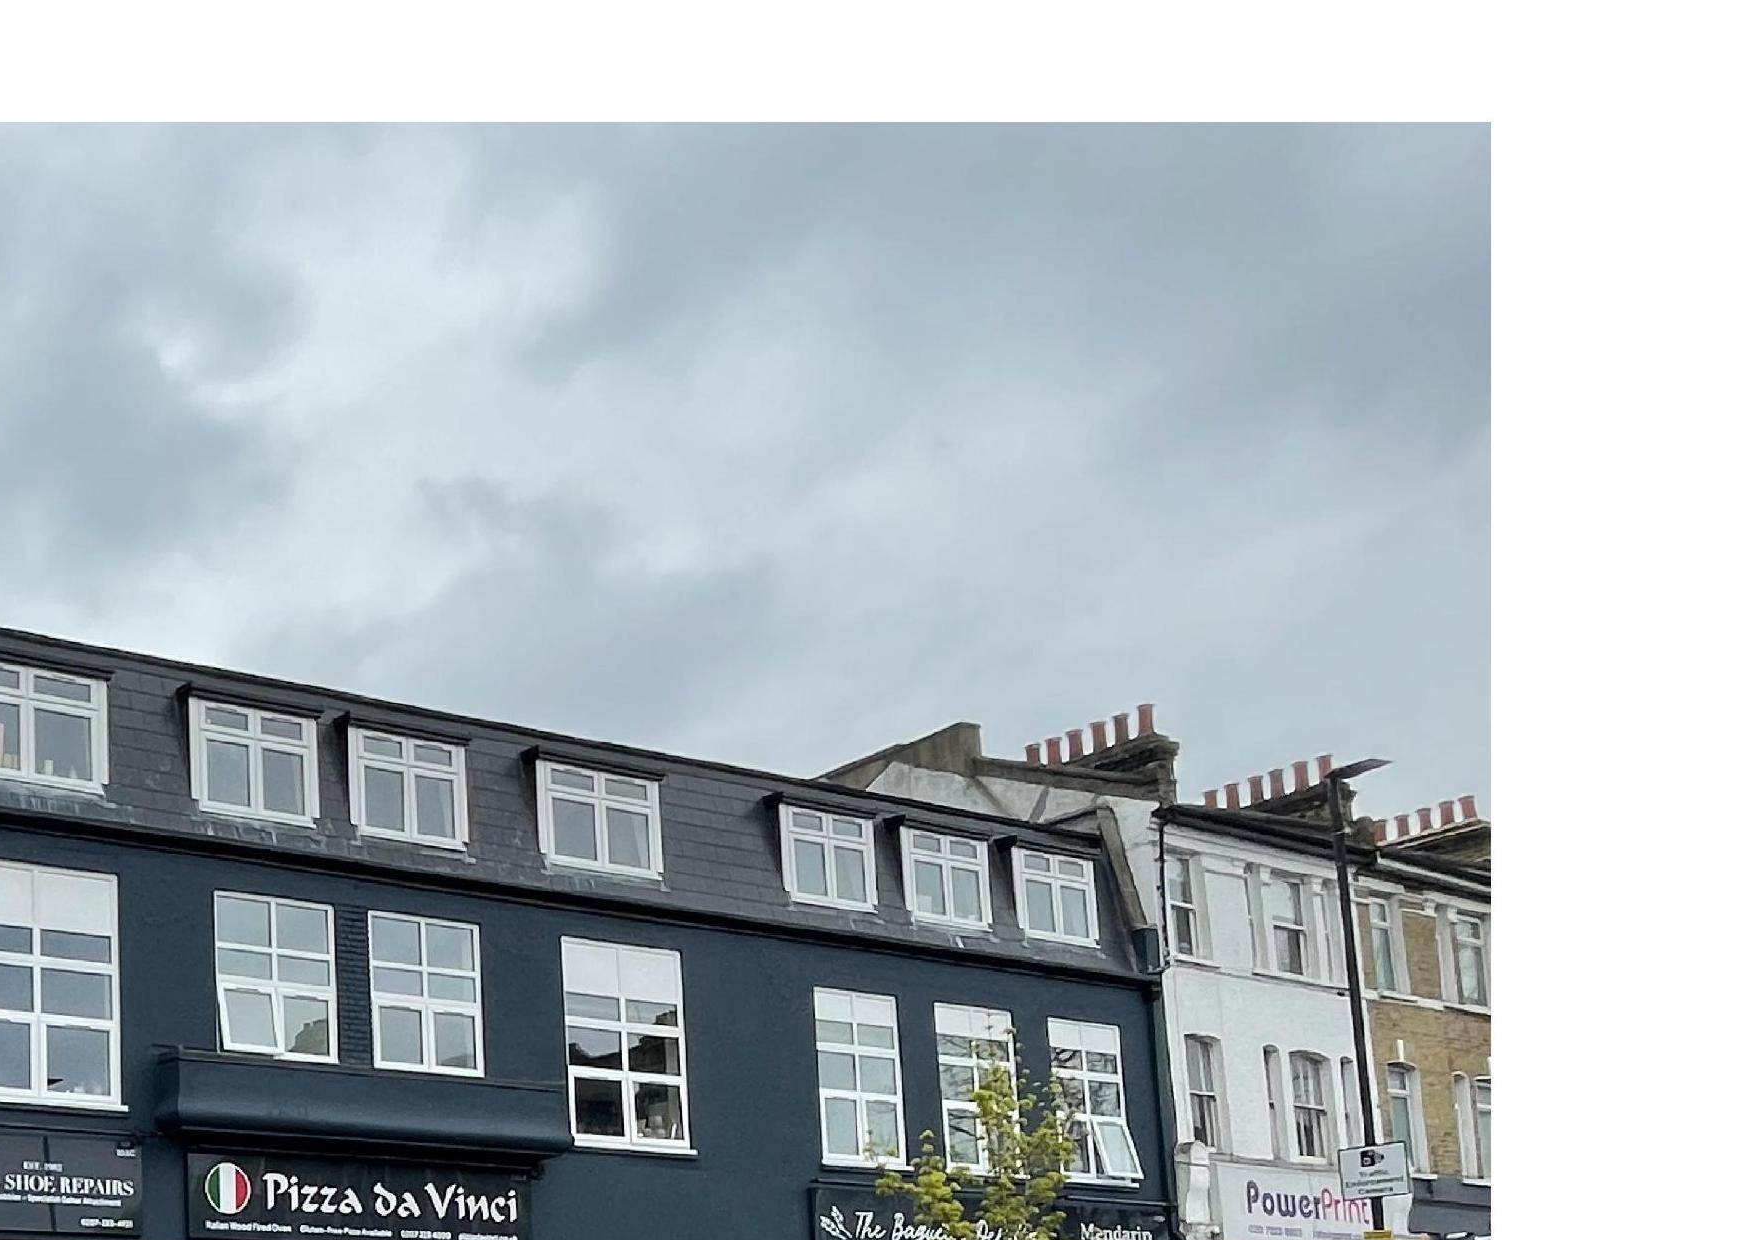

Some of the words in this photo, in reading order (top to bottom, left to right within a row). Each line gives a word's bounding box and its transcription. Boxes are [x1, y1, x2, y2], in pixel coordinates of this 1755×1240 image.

[4, 1173, 56, 1193] SHOE
[60, 1176, 135, 1197] REPAIRS
[261, 1172, 363, 1214] Pizza
[372, 1182, 422, 1218] da
[423, 1182, 518, 1223] Vinci
[1246, 1179, 1370, 1226] PowerPrint
[854, 1211, 887, 1240] The
